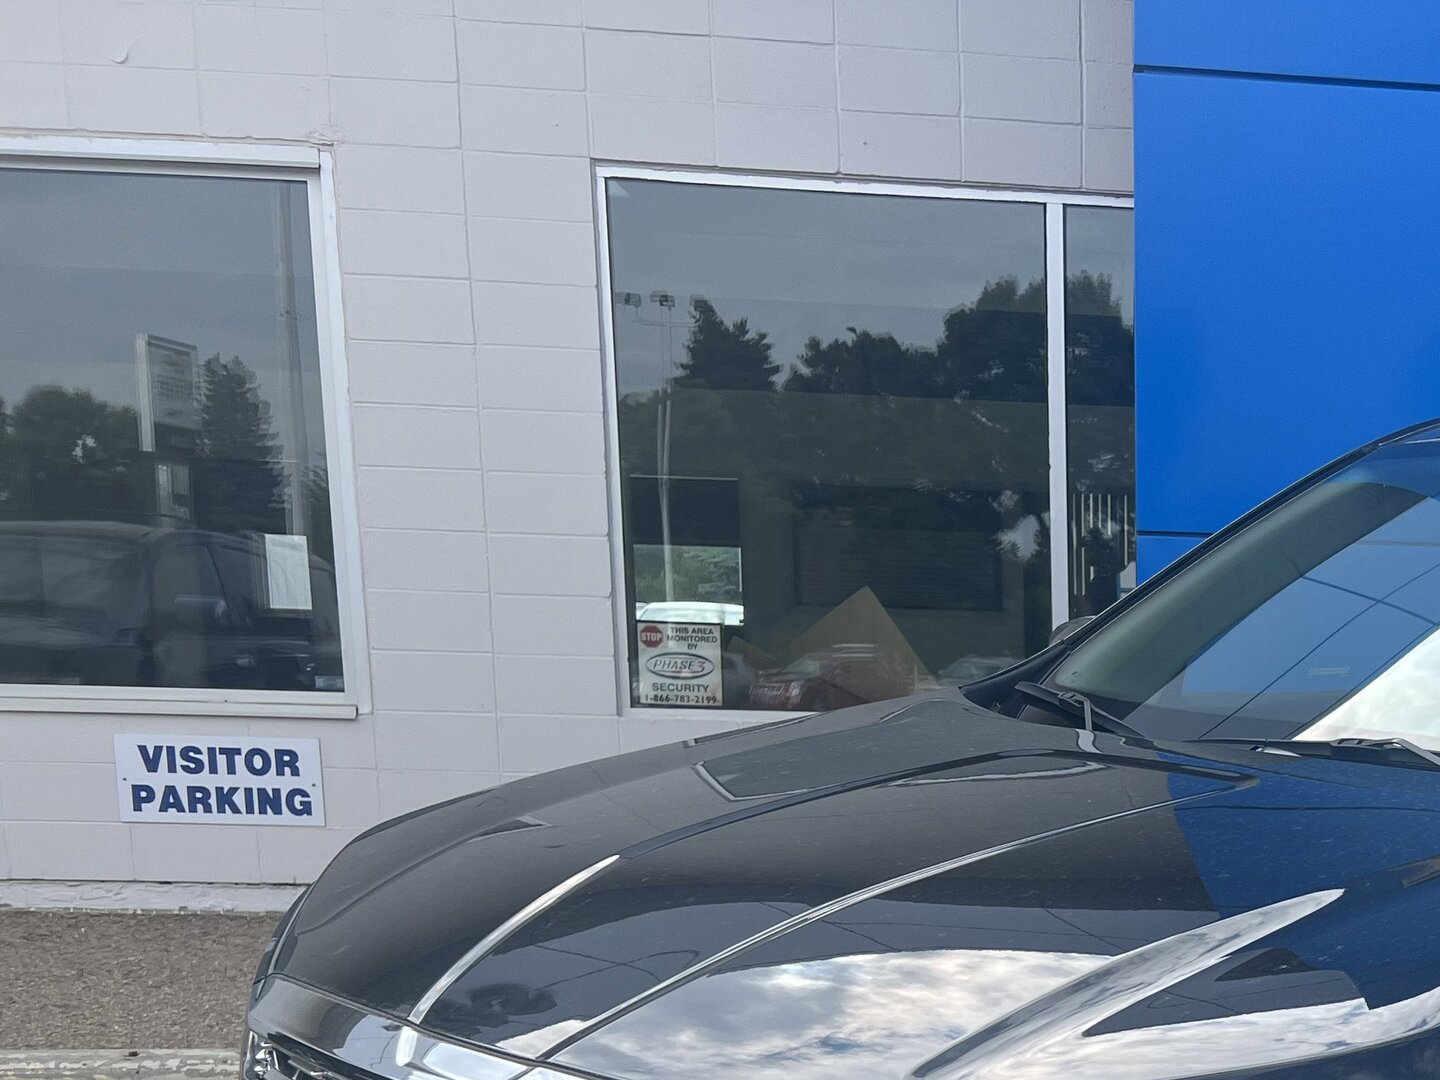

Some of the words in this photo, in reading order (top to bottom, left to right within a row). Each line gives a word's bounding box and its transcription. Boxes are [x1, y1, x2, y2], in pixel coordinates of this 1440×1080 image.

[669, 626, 689, 634] THIS
[691, 627, 714, 635] AREA
[641, 631, 663, 642] STOP
[667, 634, 718, 643] MONITORED
[652, 682, 710, 693] SECURITY
[137, 744, 300, 777] VISITOR
[131, 784, 313, 817] PARKING
